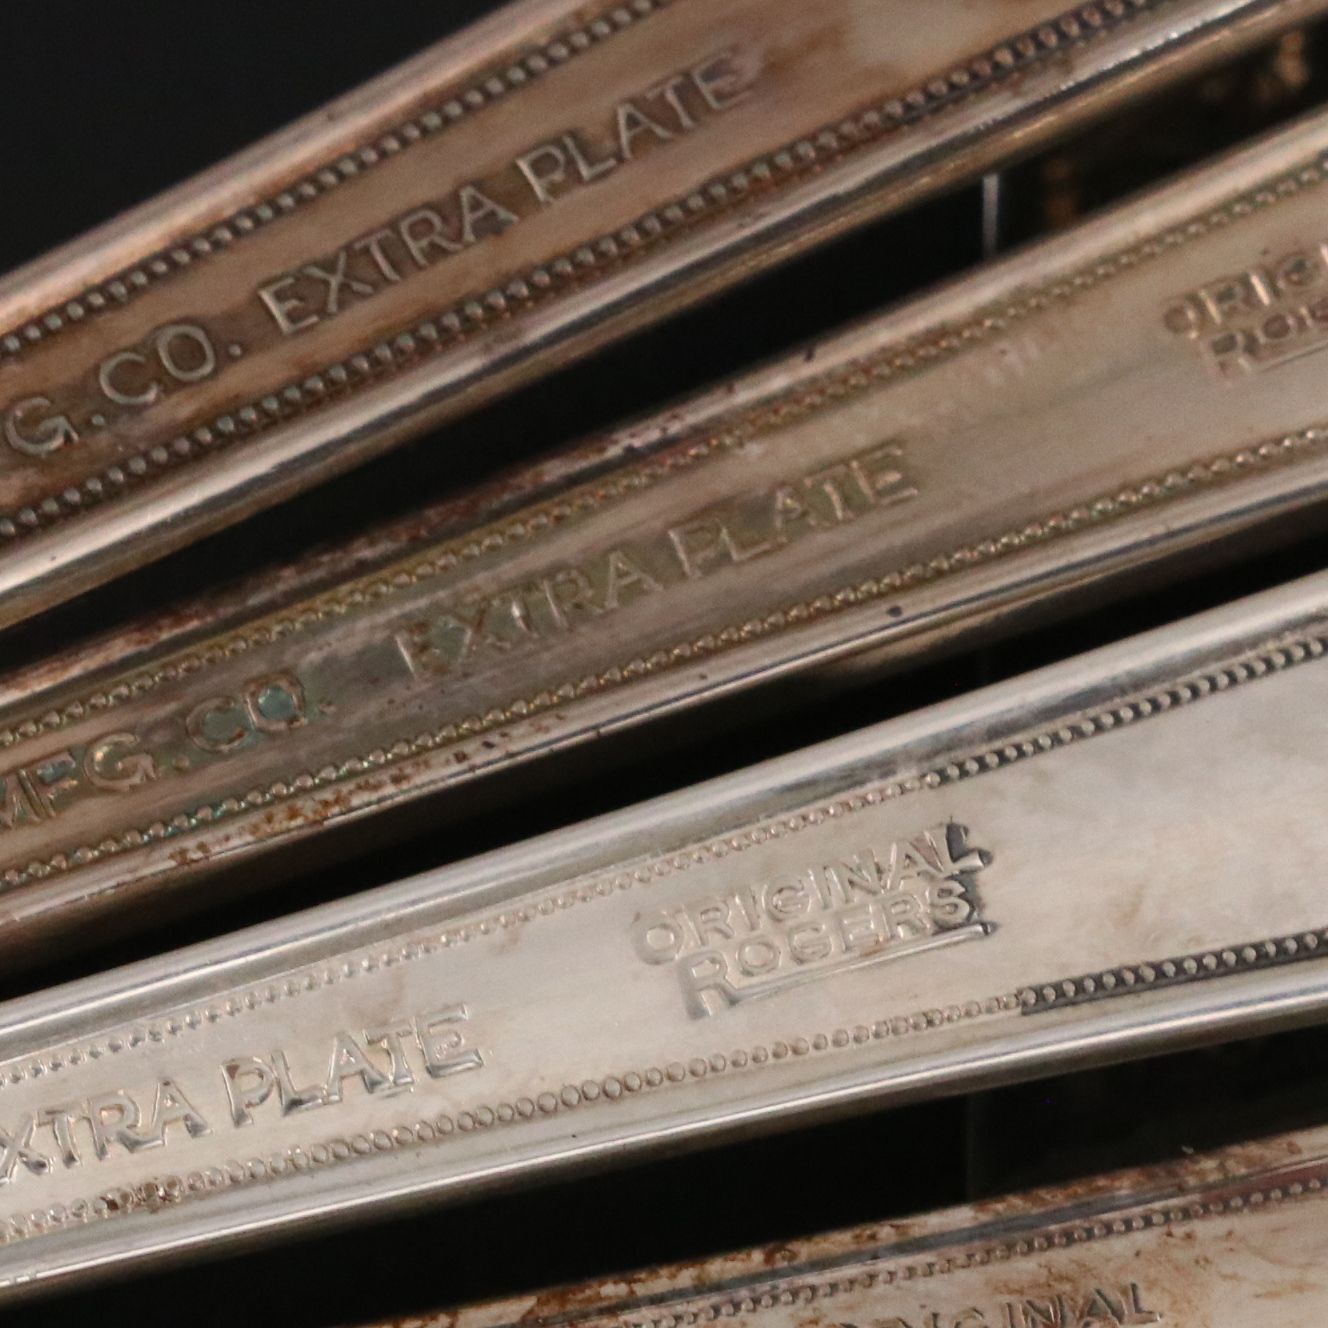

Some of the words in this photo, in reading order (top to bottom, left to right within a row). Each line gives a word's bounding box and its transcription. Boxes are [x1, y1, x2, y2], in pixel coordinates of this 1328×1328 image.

[257, 183, 520, 336] EXTRA
[514, 50, 762, 206] PLATE
[393, 547, 666, 681] EXTRA
[666, 442, 922, 579] PLATE
[631, 818, 994, 965] ORIGINAL
[675, 874, 979, 1020] ROGERS
[219, 1002, 484, 1129] PLATE
